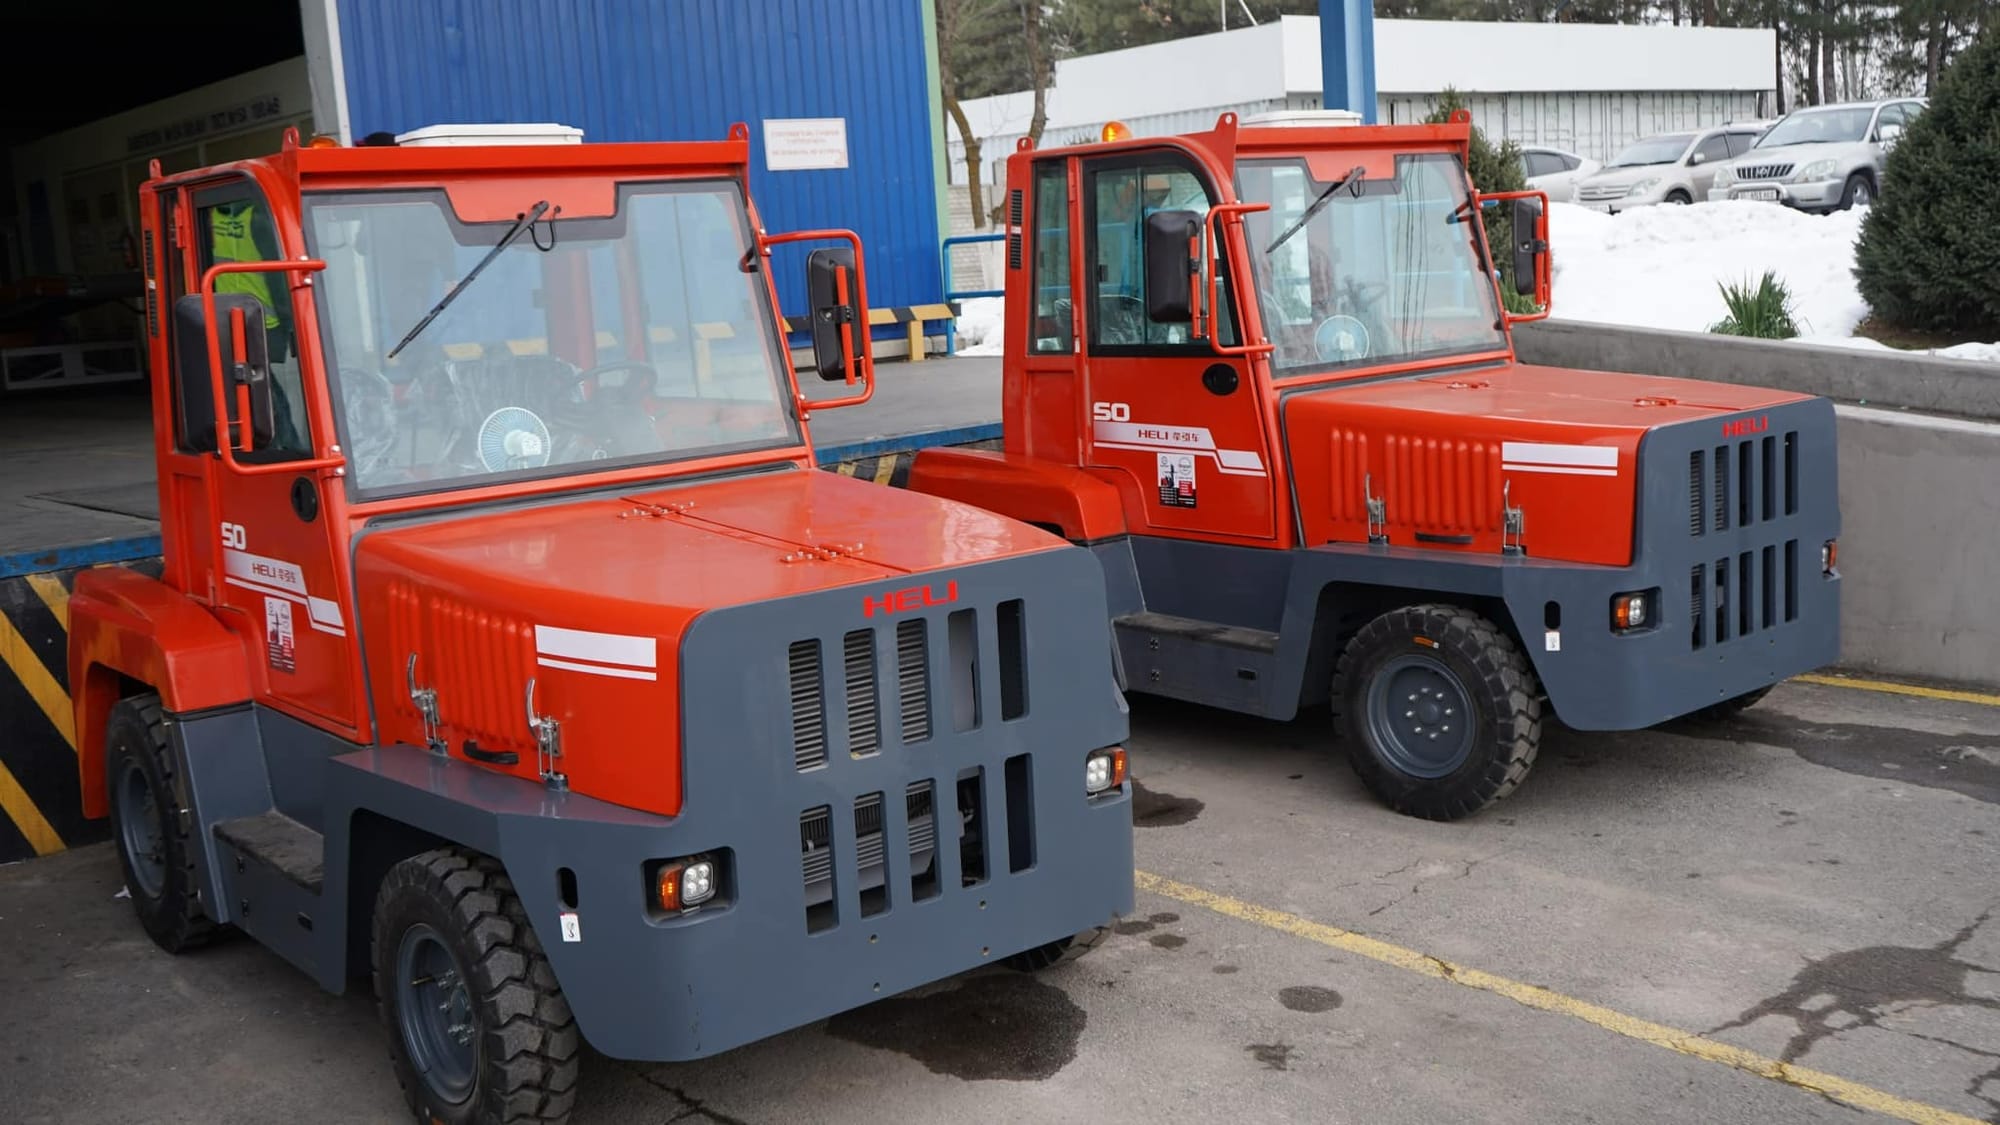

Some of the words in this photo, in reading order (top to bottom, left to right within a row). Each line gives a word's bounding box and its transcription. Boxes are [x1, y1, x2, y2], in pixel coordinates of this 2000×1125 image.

[1138, 429, 1169, 440] HELI
[1722, 415, 1769, 438] HELI
[252, 563, 277, 578] HELI
[863, 580, 958, 618] HELI
